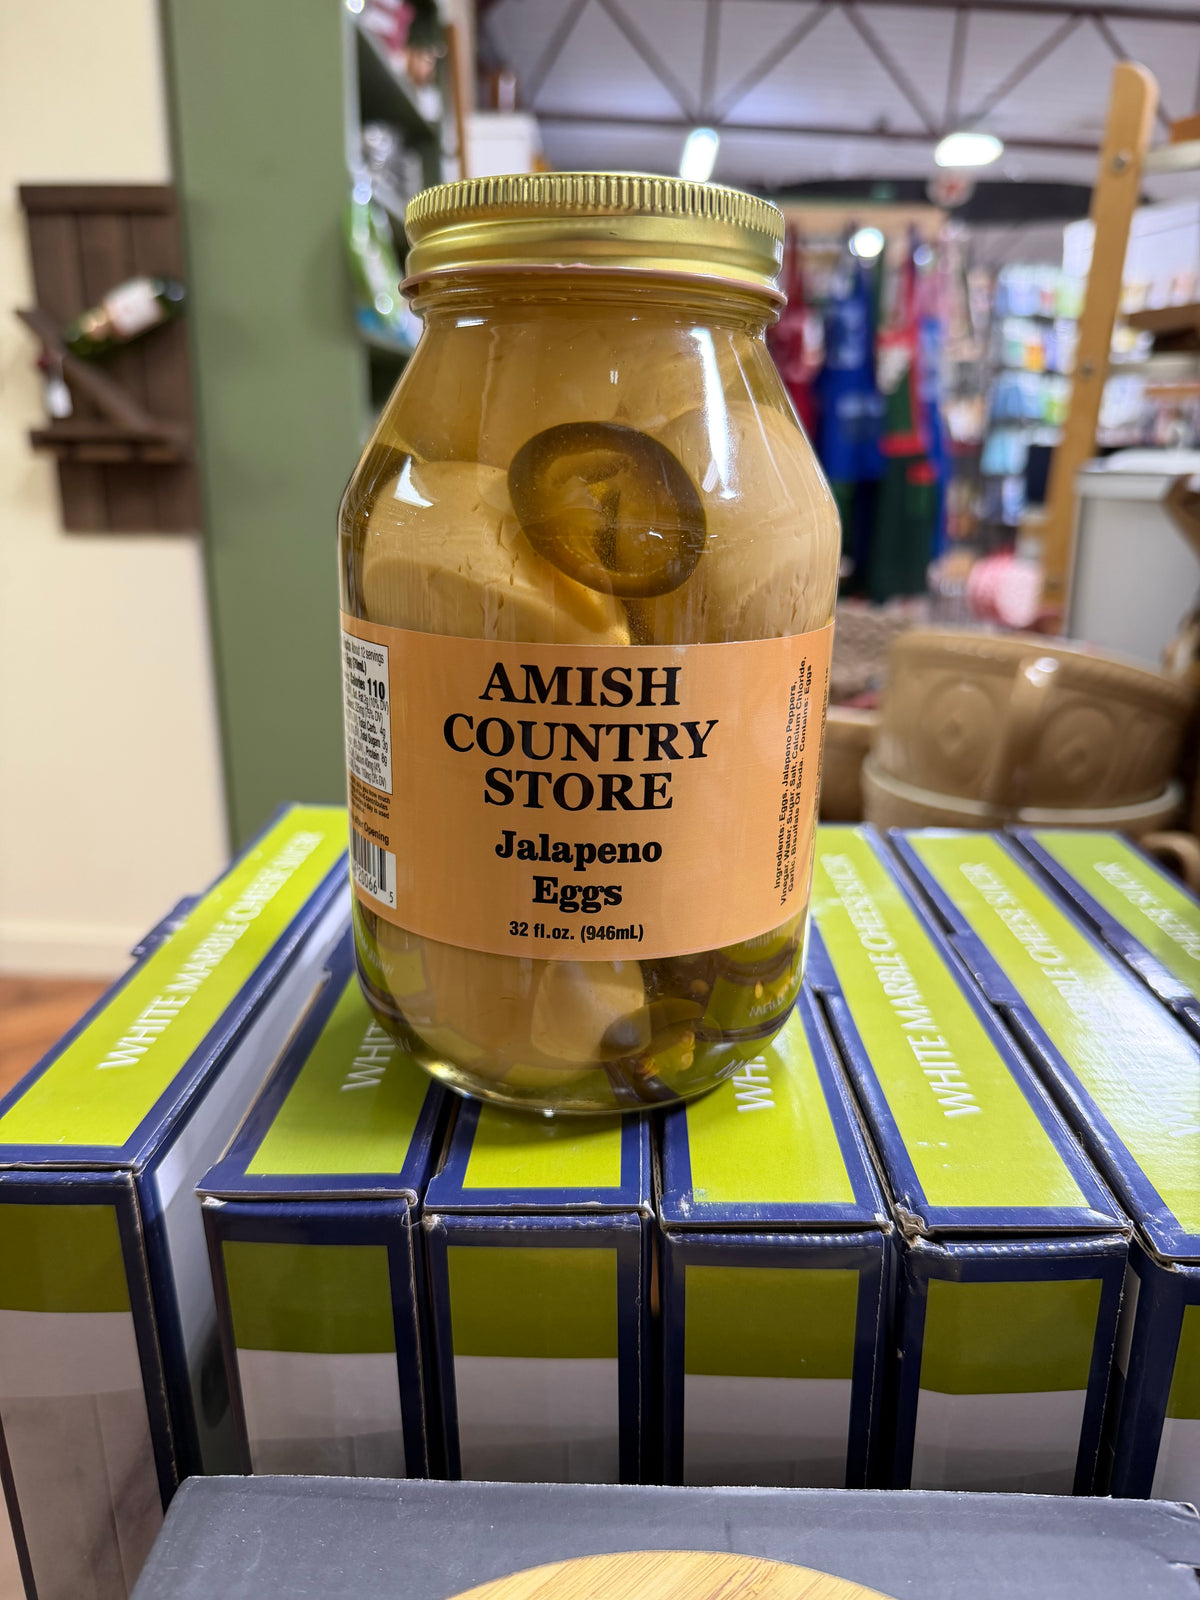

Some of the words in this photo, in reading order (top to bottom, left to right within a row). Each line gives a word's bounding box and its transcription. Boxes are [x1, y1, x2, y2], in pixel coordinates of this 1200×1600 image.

[367, 677, 386, 700] 110
[478, 662, 682, 708] AMISH
[795, 656, 807, 710] Chloride,
[785, 681, 797, 733] Peppers,
[799, 697, 809, 752] Contains:
[804, 664, 812, 695] Eggs
[443, 713, 719, 763] COUNTRY
[791, 712, 801, 760] Calcium
[781, 735, 792, 787] Jalapeno
[789, 760, 799, 787] Salt,
[484, 767, 673, 812] STORE
[778, 788, 789, 822] Eggs,
[786, 788, 796, 825] Sugar,
[363, 821, 389, 847] Opening
[495, 830, 663, 871] Jalapeno
[774, 823, 785, 889] Ingredients:
[783, 826, 793, 861] Water,
[532, 875, 623, 914] Eggs
[780, 860, 790, 906] Vinegar,
[509, 920, 529, 937] 32
[533, 923, 575, 940] fl.oz.
[580, 924, 644, 943] (946mL)
[97, 996, 191, 1069] WHITE
[165, 922, 250, 991] MARBLE
[868, 951, 937, 1032] MARBLE
[341, 1019, 395, 1091] WHIT
[906, 1034, 982, 1117] WHITE
